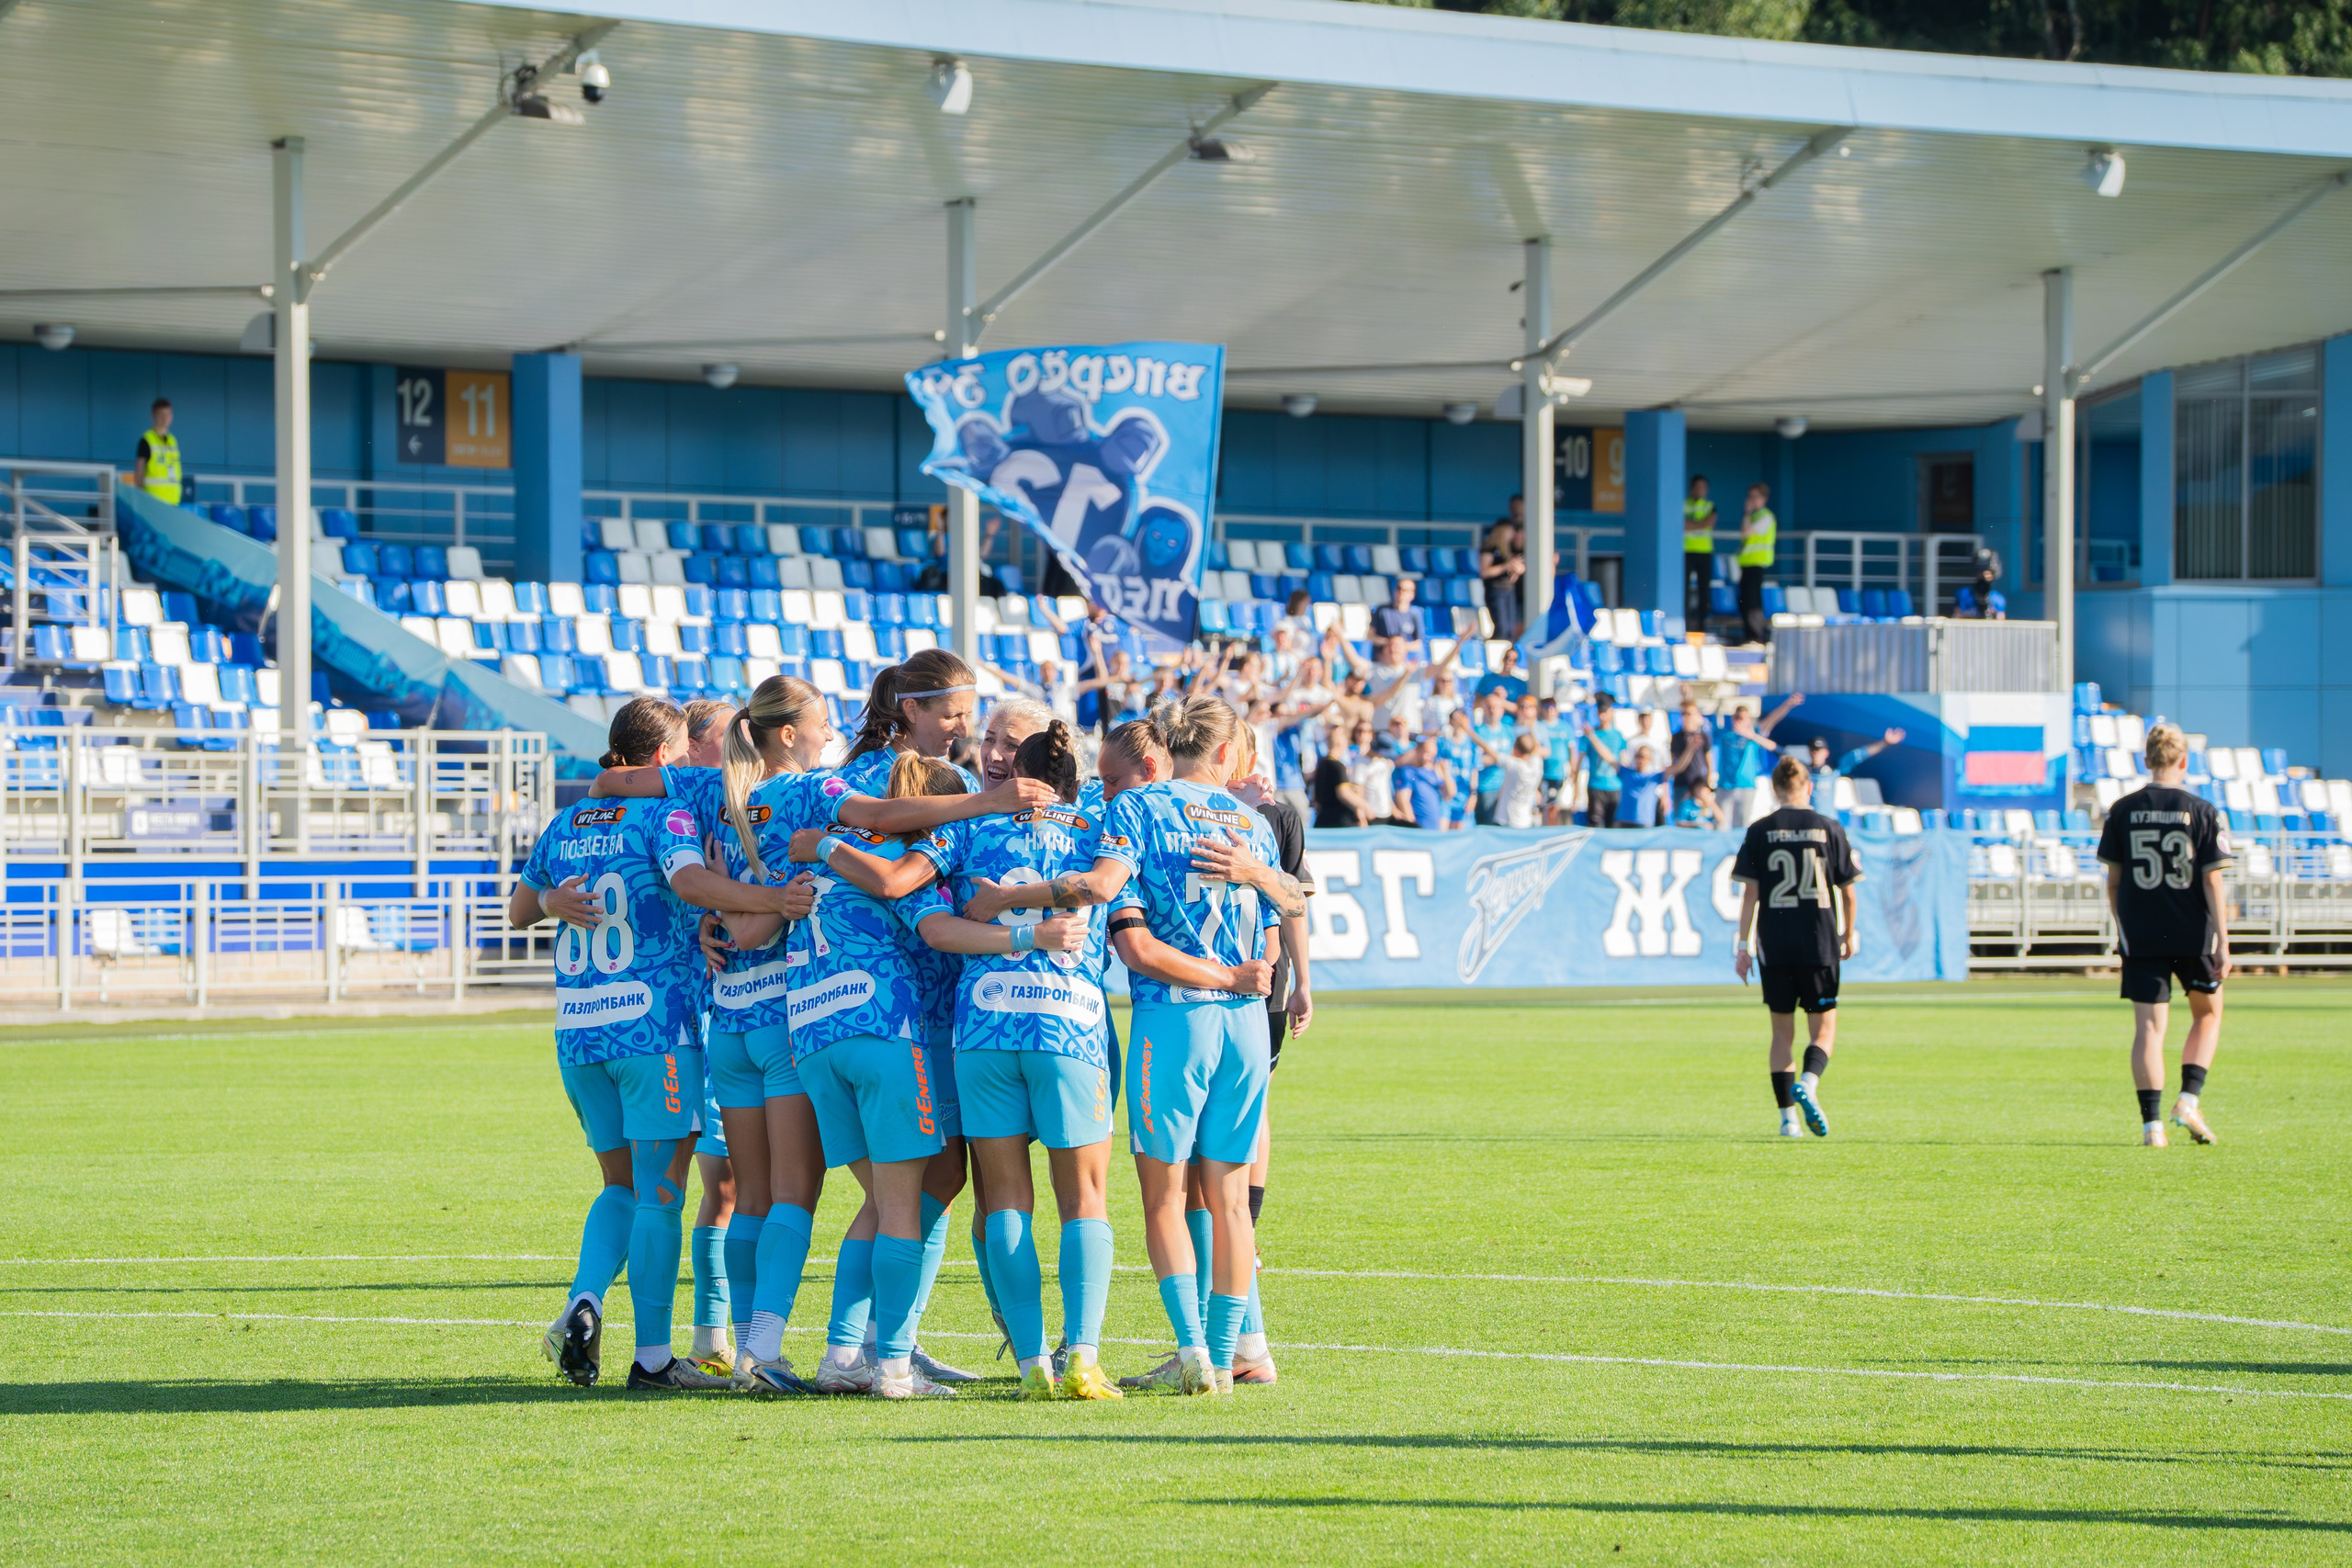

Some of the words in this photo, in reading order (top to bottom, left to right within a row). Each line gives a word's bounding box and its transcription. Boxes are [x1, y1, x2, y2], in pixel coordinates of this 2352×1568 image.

[396, 378, 433, 427] 12
[460, 382, 496, 438] 11
[1019, 809, 1075, 824] WLINE
[1190, 807, 1239, 826] WINLINE
[560, 833, 624, 861] ПОЗДЕЕВА
[2130, 829, 2194, 890] 53
[1767, 848, 1831, 908] 24
[1185, 872, 1258, 967] 71
[562, 992, 646, 1015] ГАЗПРОМБАНК
[789, 982, 868, 1017] ГАЗПРОМБАНК
[1011, 985, 1101, 1015] ГАЗПРОМБАНК
[910, 1042, 935, 1135] G-ENERG
